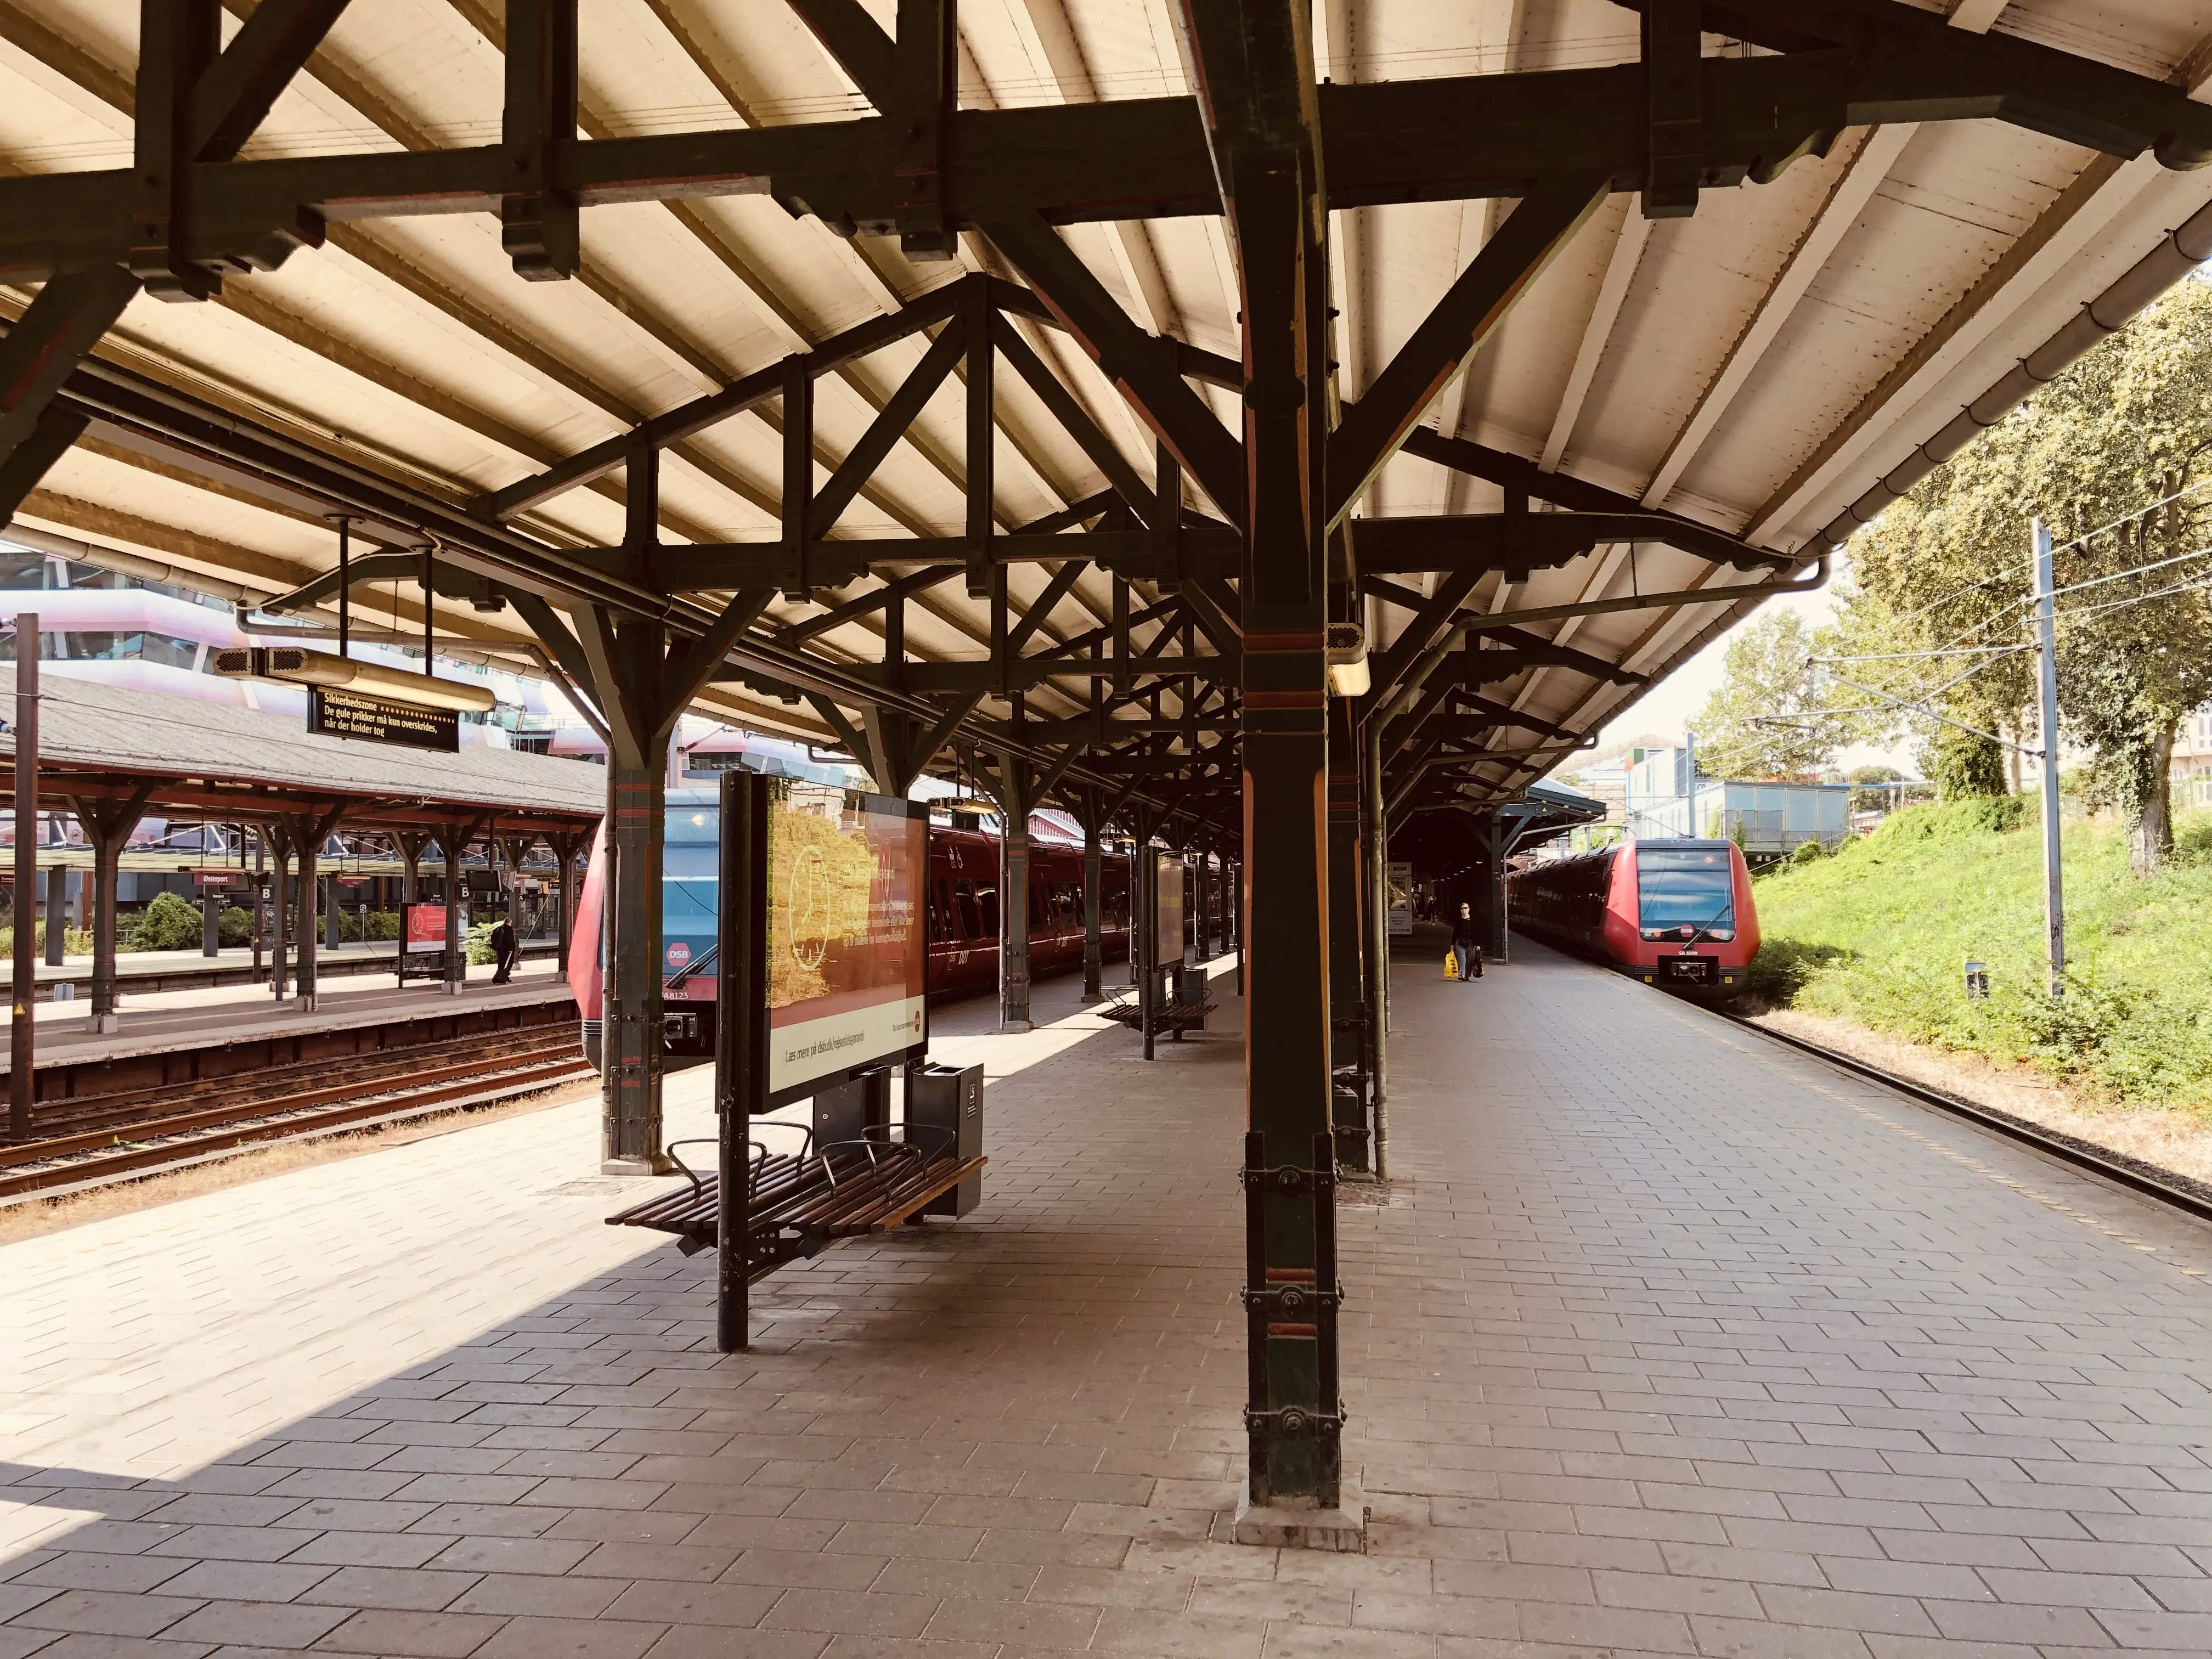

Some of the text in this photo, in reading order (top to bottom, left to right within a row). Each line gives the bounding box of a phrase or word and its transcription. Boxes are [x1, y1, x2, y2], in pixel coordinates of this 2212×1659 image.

[324, 692, 377, 711] Sikkerhedszone
[324, 705, 437, 734] De gule prikker må kun overskrides,
[324, 718, 385, 737] når der holder tog
[204, 875, 228, 883] Østerport
[263, 888, 270, 899] B
[462, 887, 469, 897] B
[669, 950, 688, 958] DSB
[786, 1050, 795, 1063] Læs
[797, 1047, 809, 1059] mere
[810, 1042, 816, 1059] på
